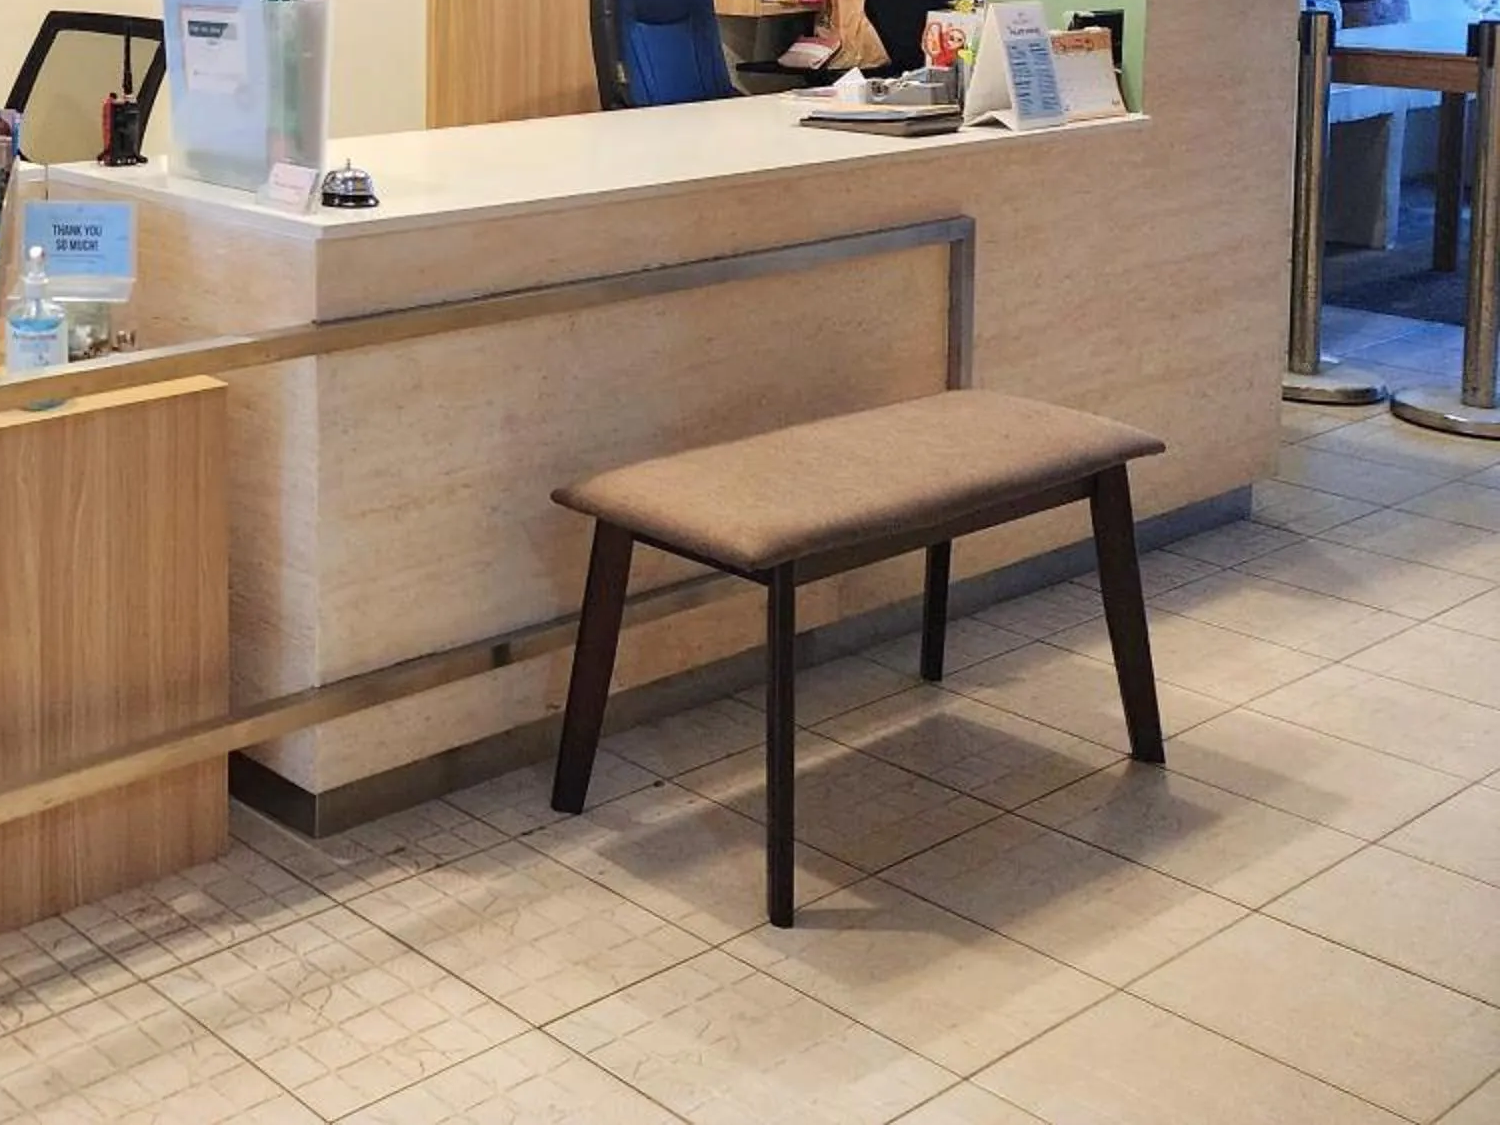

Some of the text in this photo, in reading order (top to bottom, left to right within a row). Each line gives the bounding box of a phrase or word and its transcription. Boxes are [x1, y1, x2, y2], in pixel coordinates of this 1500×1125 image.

[53, 223, 103, 236] THANK YOU
[56, 239, 67, 251] SO
